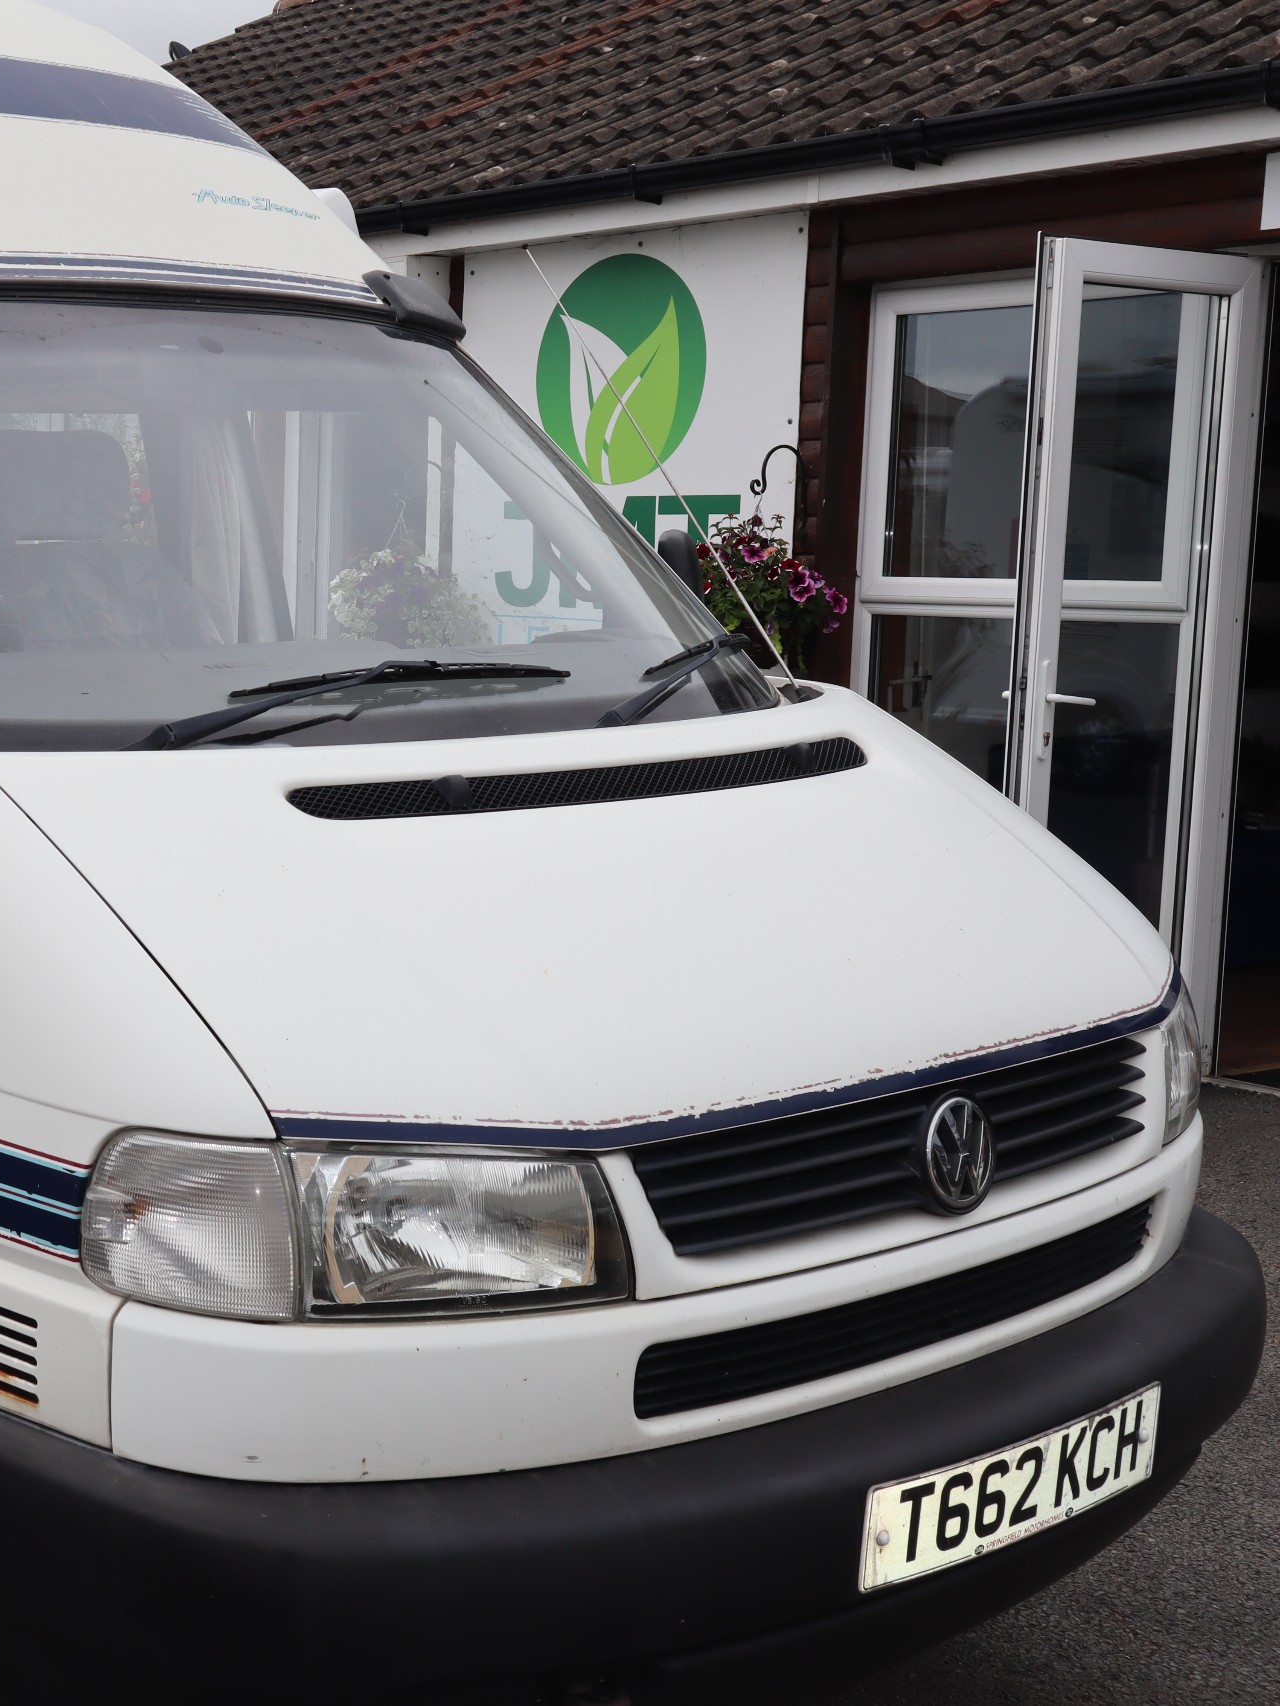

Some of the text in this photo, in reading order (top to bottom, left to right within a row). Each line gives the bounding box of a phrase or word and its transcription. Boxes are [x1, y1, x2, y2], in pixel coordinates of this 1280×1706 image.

[900, 1399, 1144, 1563] T662 KCH
[985, 1529, 1022, 1551] SPRINGFIELD
[1024, 1511, 1065, 1533] MOTORHOMES
